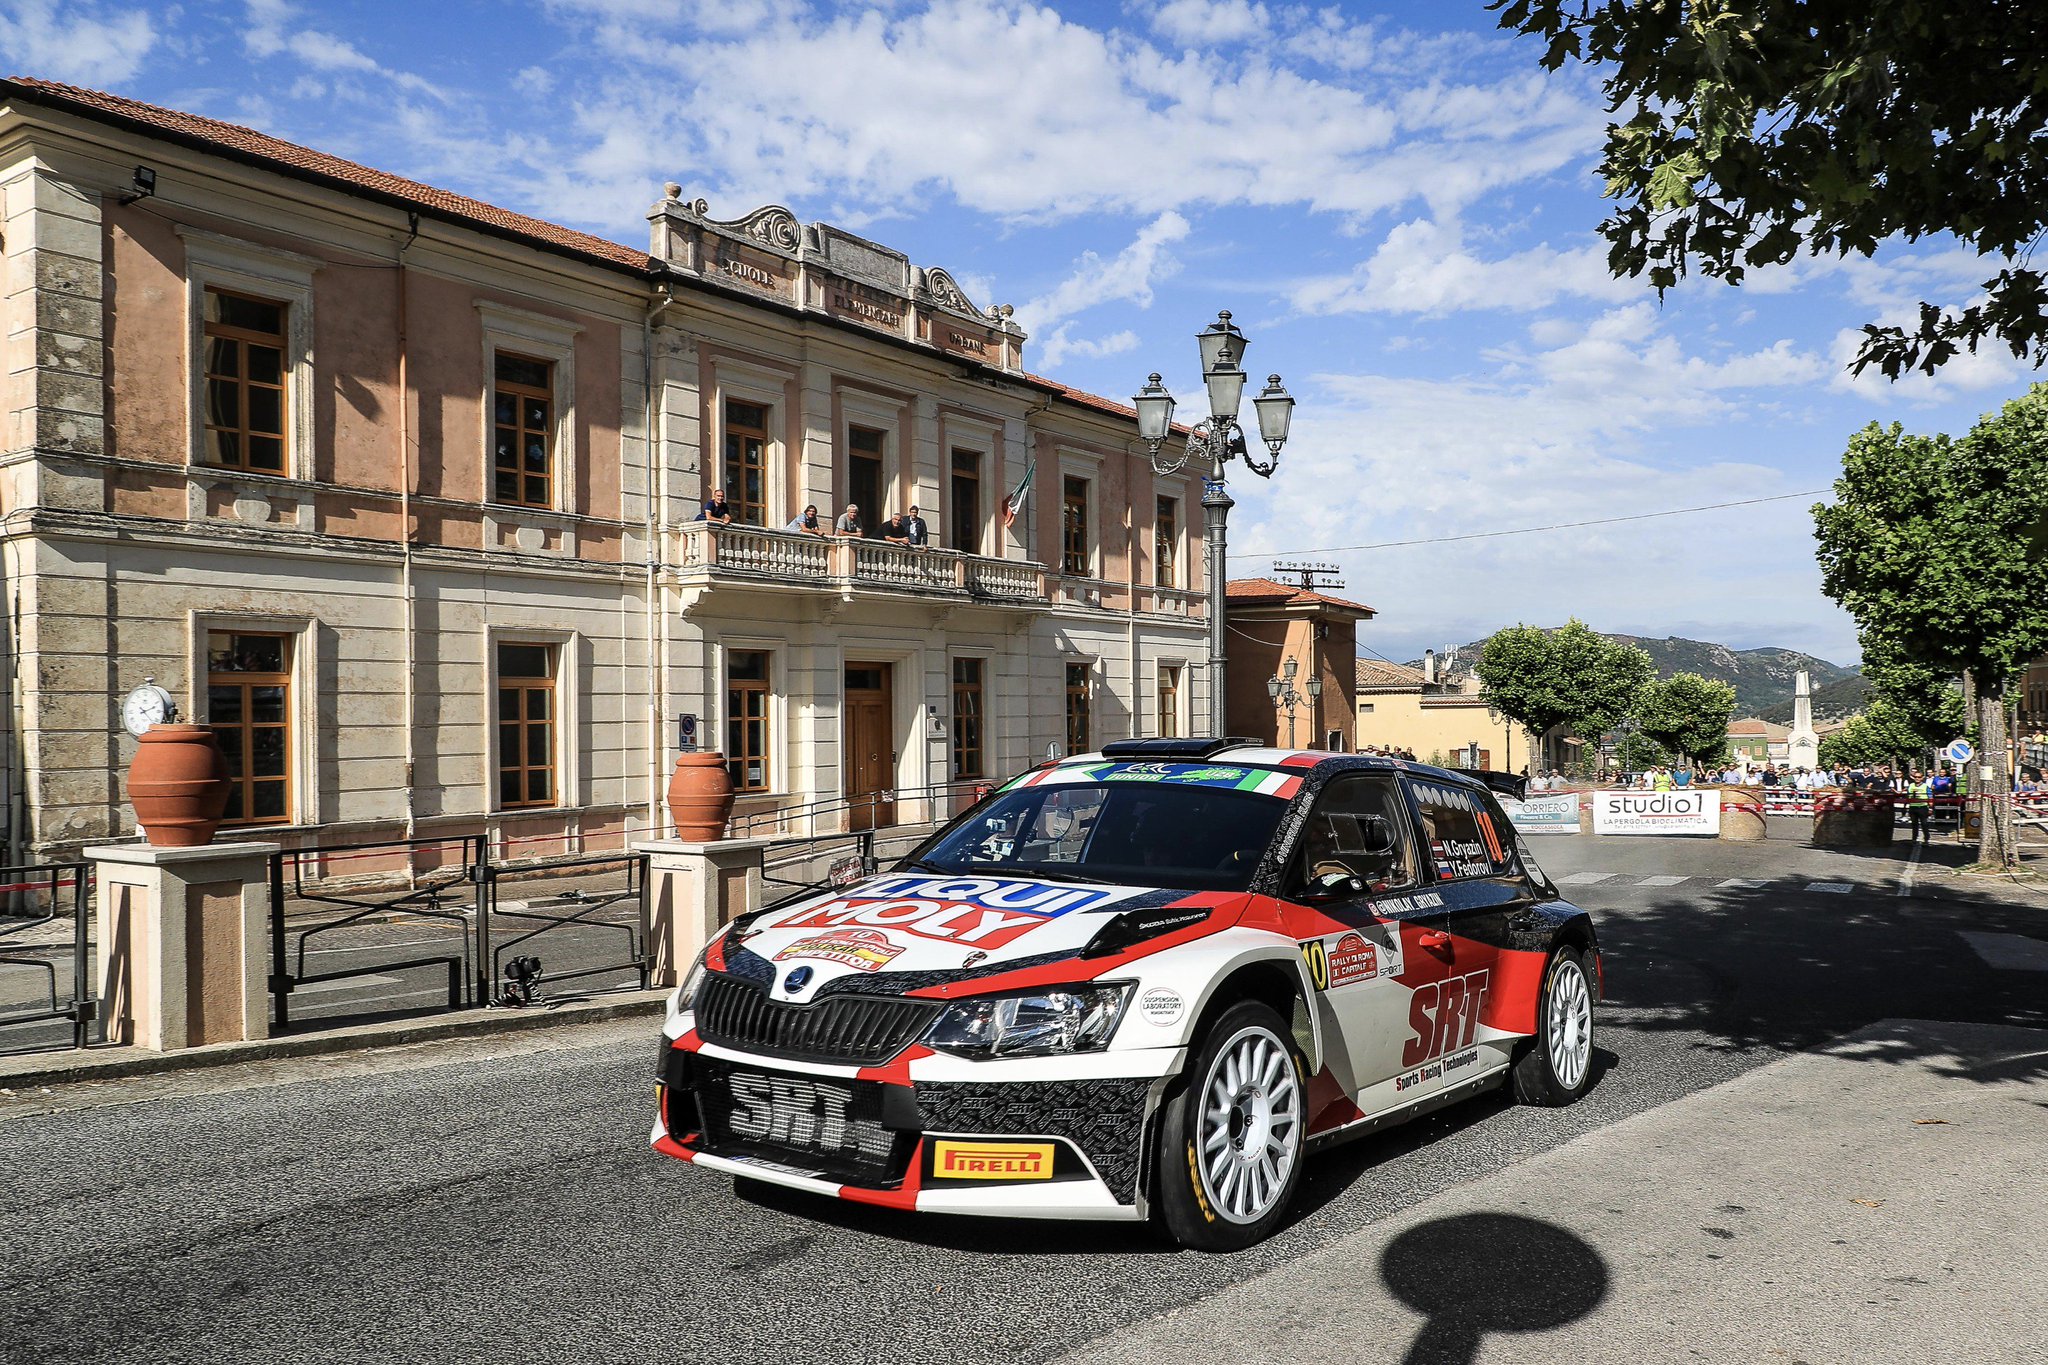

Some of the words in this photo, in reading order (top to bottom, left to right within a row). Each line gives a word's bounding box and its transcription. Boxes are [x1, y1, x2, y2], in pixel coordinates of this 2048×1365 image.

[722, 259, 775, 285] SCUOLE
[950, 332, 985, 351] URBANE
[1477, 811, 1504, 864] 10
[1442, 840, 1482, 860] N.Gryazin
[1451, 861, 1490, 877] Y.Fedorov
[864, 878, 1096, 914] LIQUI
[786, 900, 1046, 942] MOLY
[1331, 955, 1350, 967] RALLY
[1358, 951, 1374, 961] ROMA
[1341, 962, 1367, 974] CAPITALE
[1401, 968, 1489, 1069] SRT
[1395, 1071, 1420, 1091] Sports
[1420, 1064, 1442, 1083] Racing
[1442, 1050, 1478, 1073] Technologies
[917, 1091, 944, 1102] SRT
[962, 1097, 989, 1109] SRT
[729, 1072, 853, 1151] SRT
[1007, 1103, 1034, 1114] SRT
[1052, 1109, 1078, 1119] SRT
[1098, 1114, 1123, 1125] SRT
[944, 1149, 1042, 1172] PIRELLI
[1092, 1154, 1117, 1165] SRT
